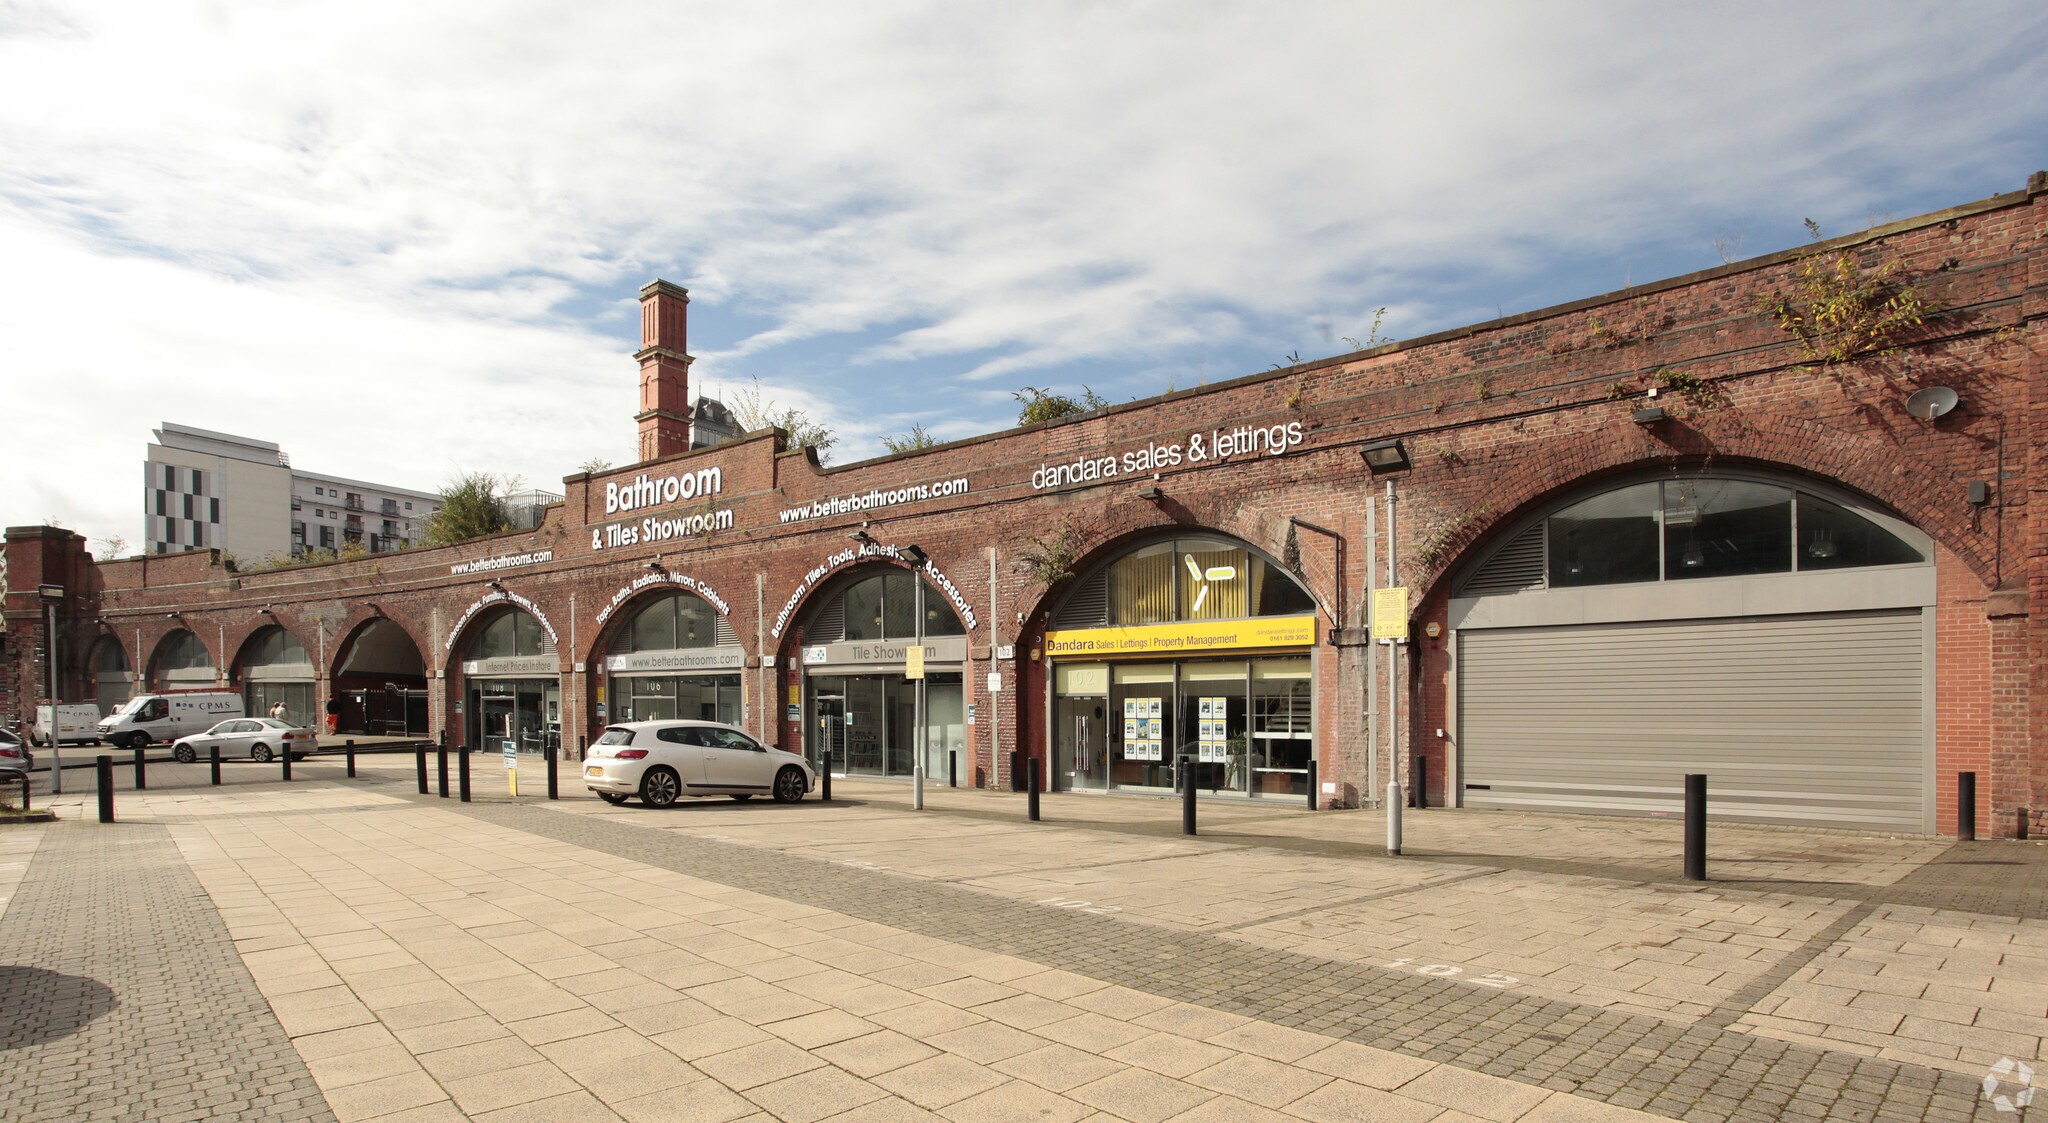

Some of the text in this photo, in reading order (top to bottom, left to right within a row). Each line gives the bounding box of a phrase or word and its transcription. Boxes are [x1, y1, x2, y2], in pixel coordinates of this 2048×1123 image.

[1031, 421, 1303, 490] dandara sales & lettings
[606, 466, 722, 514] Bathroom
[779, 478, 969, 523] www.betterbathrooms.com
[592, 509, 733, 550] & Tiles Showroom
[451, 550, 552, 575] www.betterbathrooms.com
[596, 572, 731, 625] Taps, Baths, Radiators, Mirrors, Cabinets
[771, 584, 806, 639] Bathroom
[804, 563, 828, 587] Tiles,
[827, 548, 856, 569] Tools,
[926, 559, 977, 630] Accessories
[445, 614, 467, 650] Bathroom
[466, 600, 482, 617] Suites,
[508, 591, 533, 611] Showers,
[532, 604, 559, 644] Enclosures
[853, 646, 870, 660] Tile
[1047, 634, 1238, 651] Dandara Sales Lettings Property Management
[486, 662, 509, 672] Internet
[510, 661, 529, 671] Prices
[530, 660, 552, 671] Instore
[631, 654, 739, 668] www.betterbathrooms.com
[647, 682, 661, 691] 106
[199, 701, 231, 711] CPMS
